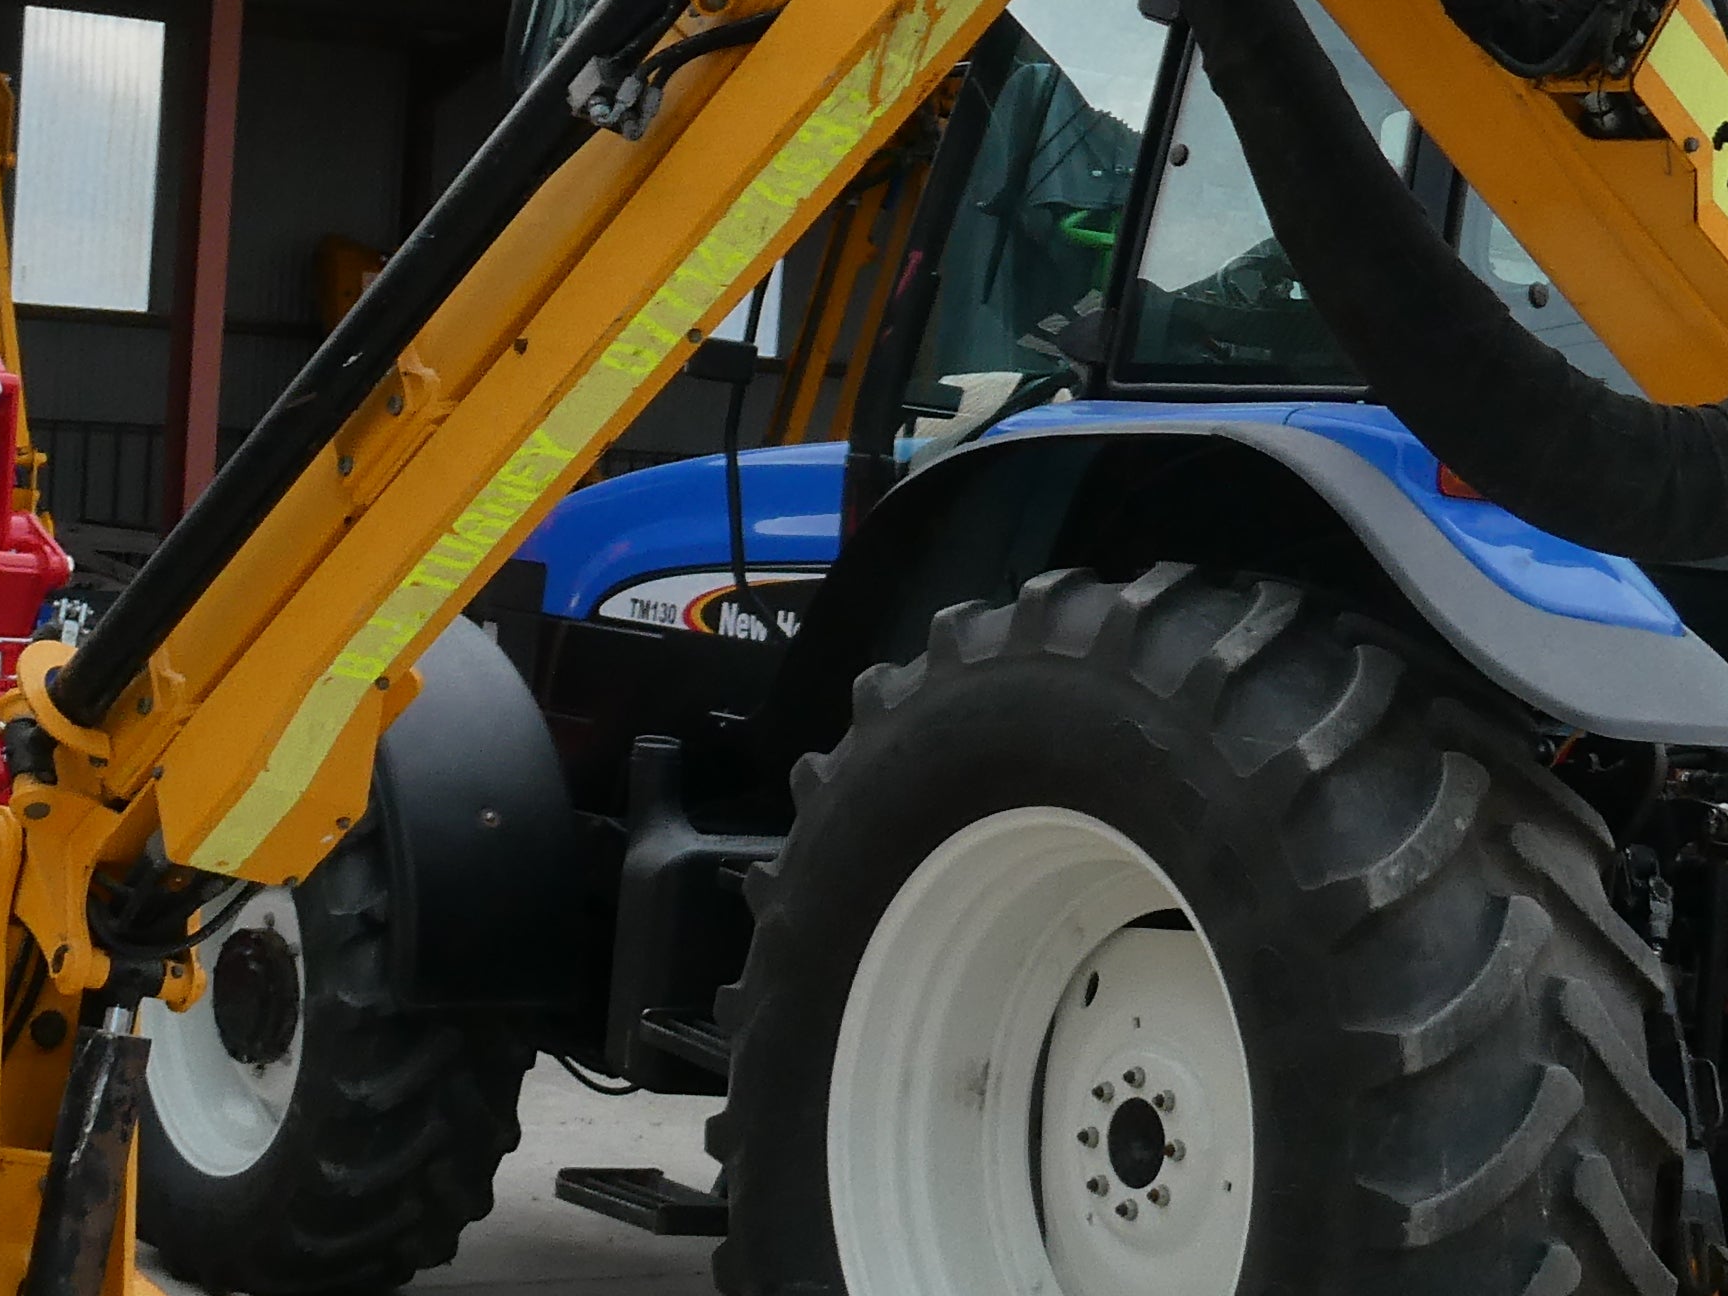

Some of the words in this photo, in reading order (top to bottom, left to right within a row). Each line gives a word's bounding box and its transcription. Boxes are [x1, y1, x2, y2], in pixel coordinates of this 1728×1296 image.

[401, 428, 578, 591] TURNEY
[630, 597, 677, 624] TM130
[719, 601, 768, 642] New
